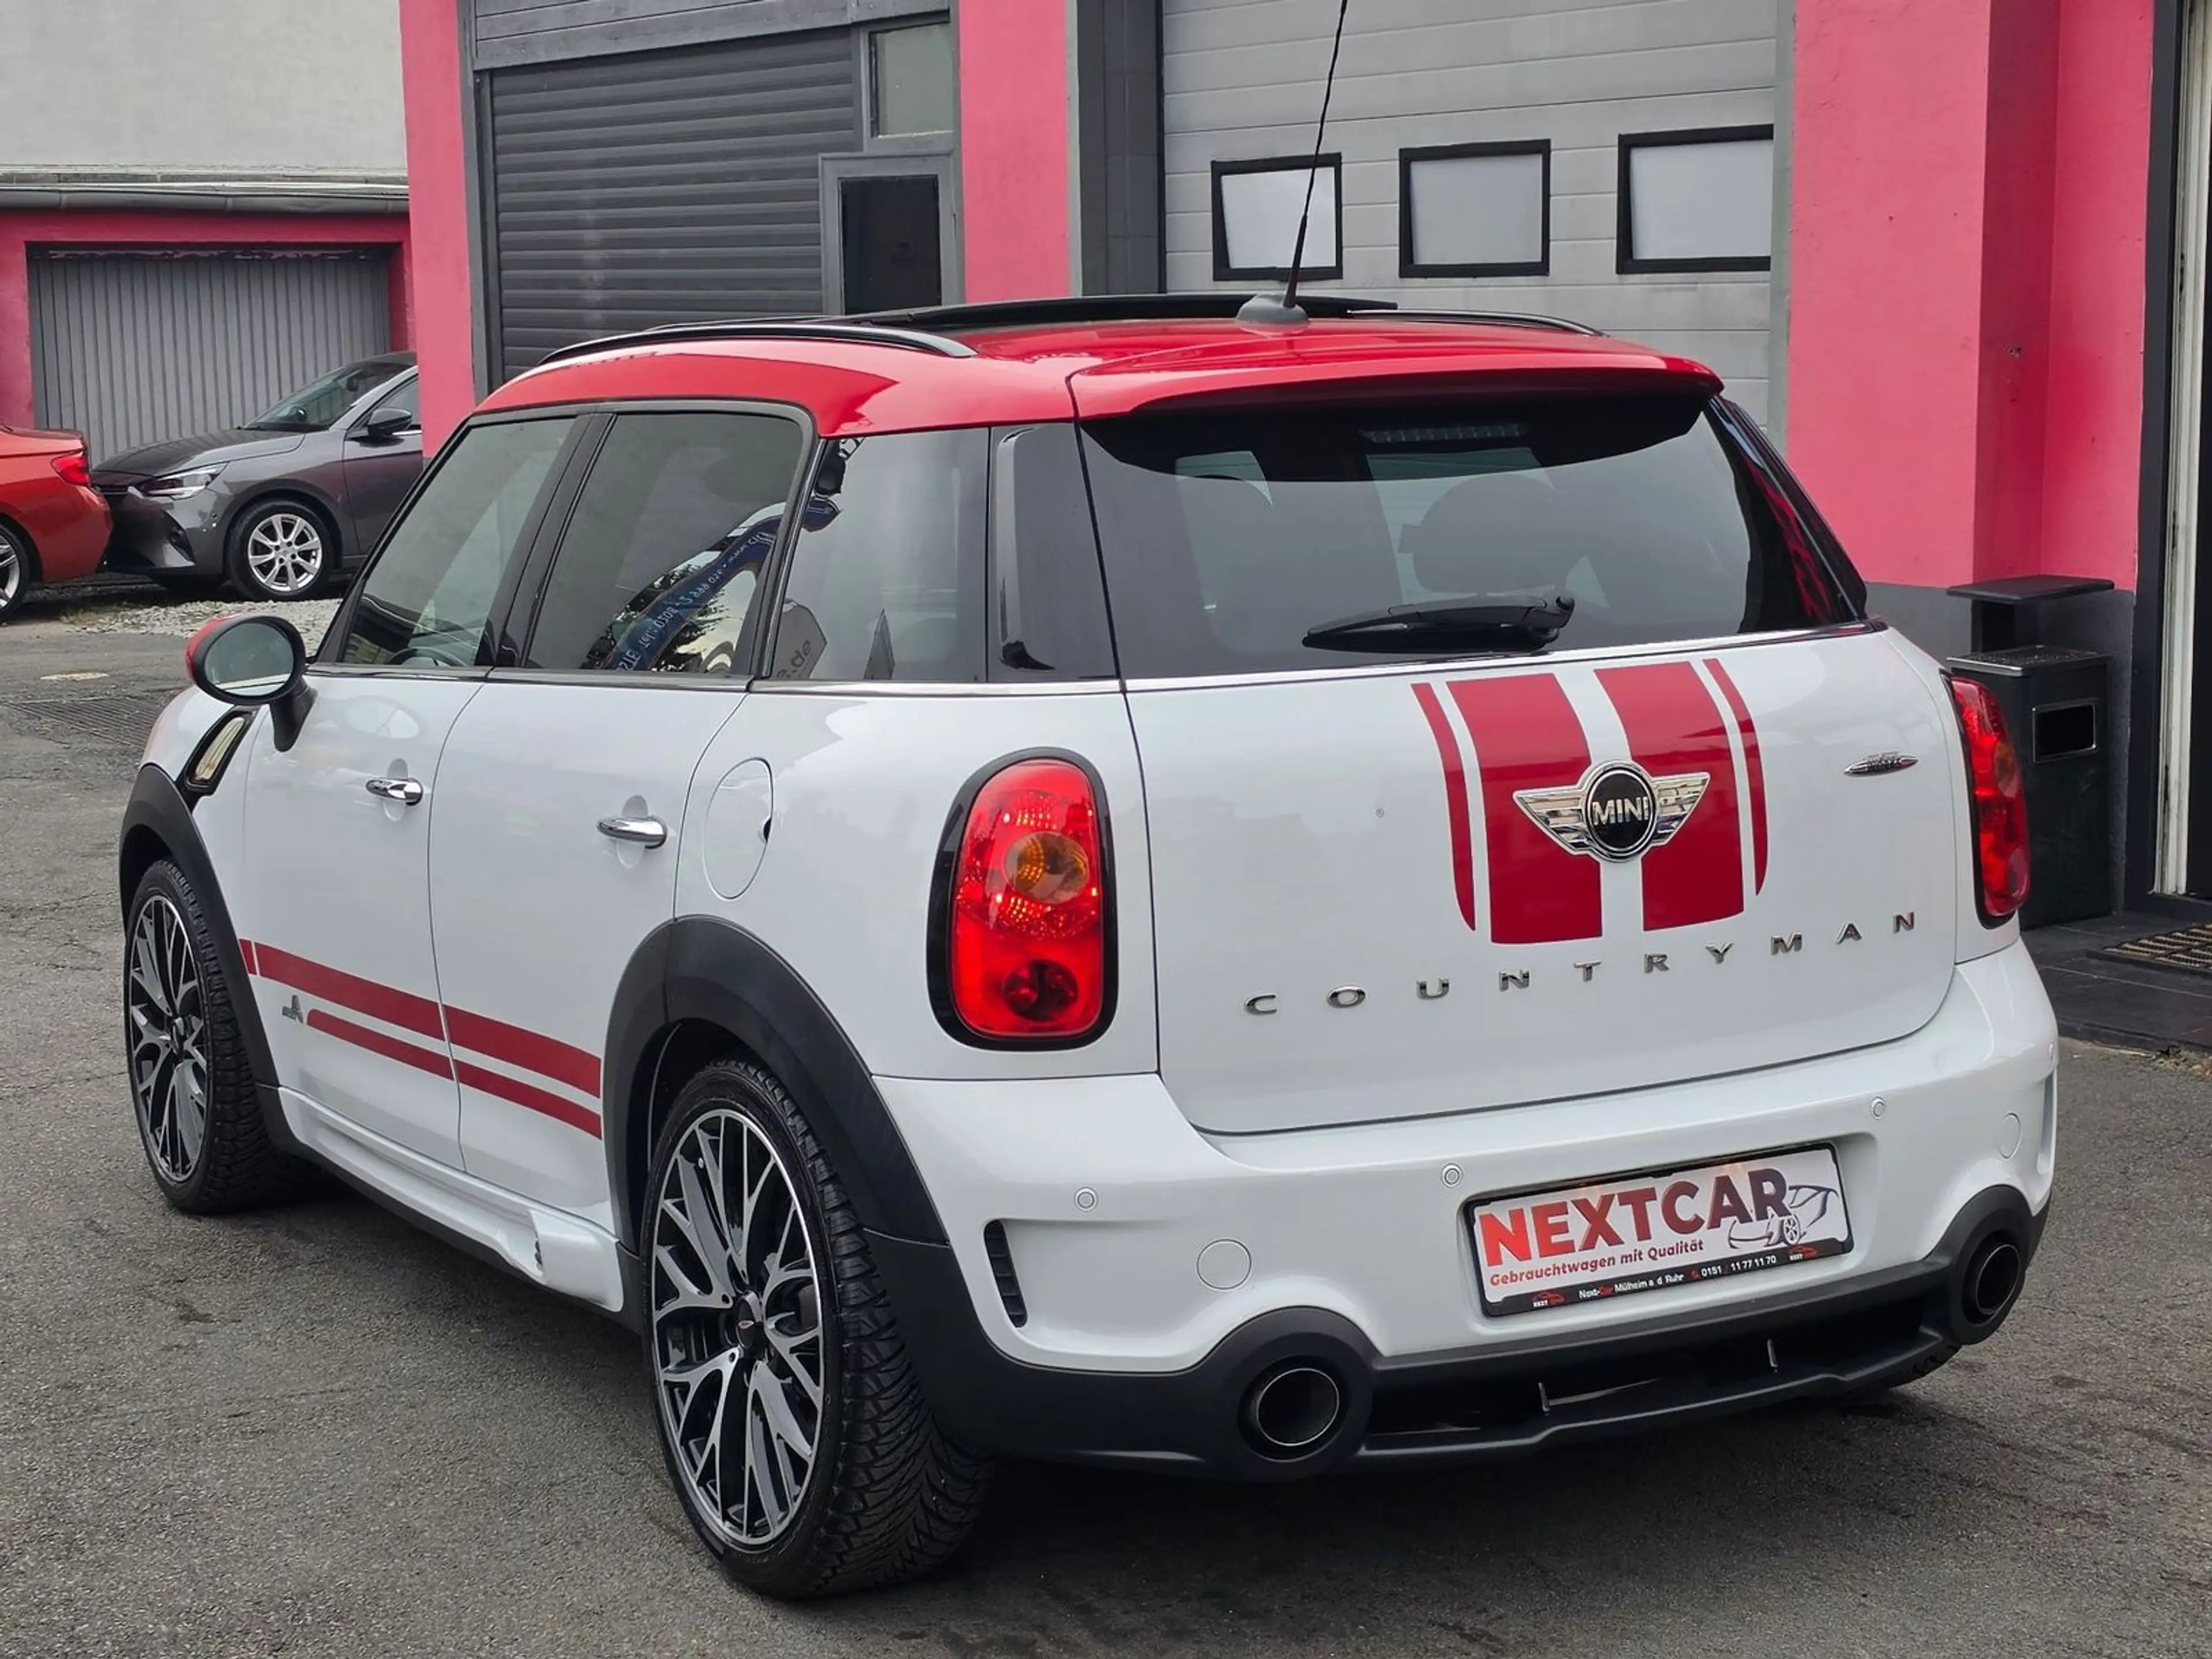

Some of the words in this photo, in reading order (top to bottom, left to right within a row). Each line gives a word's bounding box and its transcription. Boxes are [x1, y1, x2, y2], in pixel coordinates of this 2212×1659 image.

[1592, 796, 1651, 826] MINI
[1244, 912, 1916, 1016] COUNTRYMAN
[1479, 1168, 1792, 1267] NEXTCAR
[1490, 1256, 1616, 1286] Gebrauchtwagen
[1620, 1248, 1643, 1264] mit
[1647, 1239, 1704, 1262] Qualität
[1701, 1265, 1722, 1277] 0151
